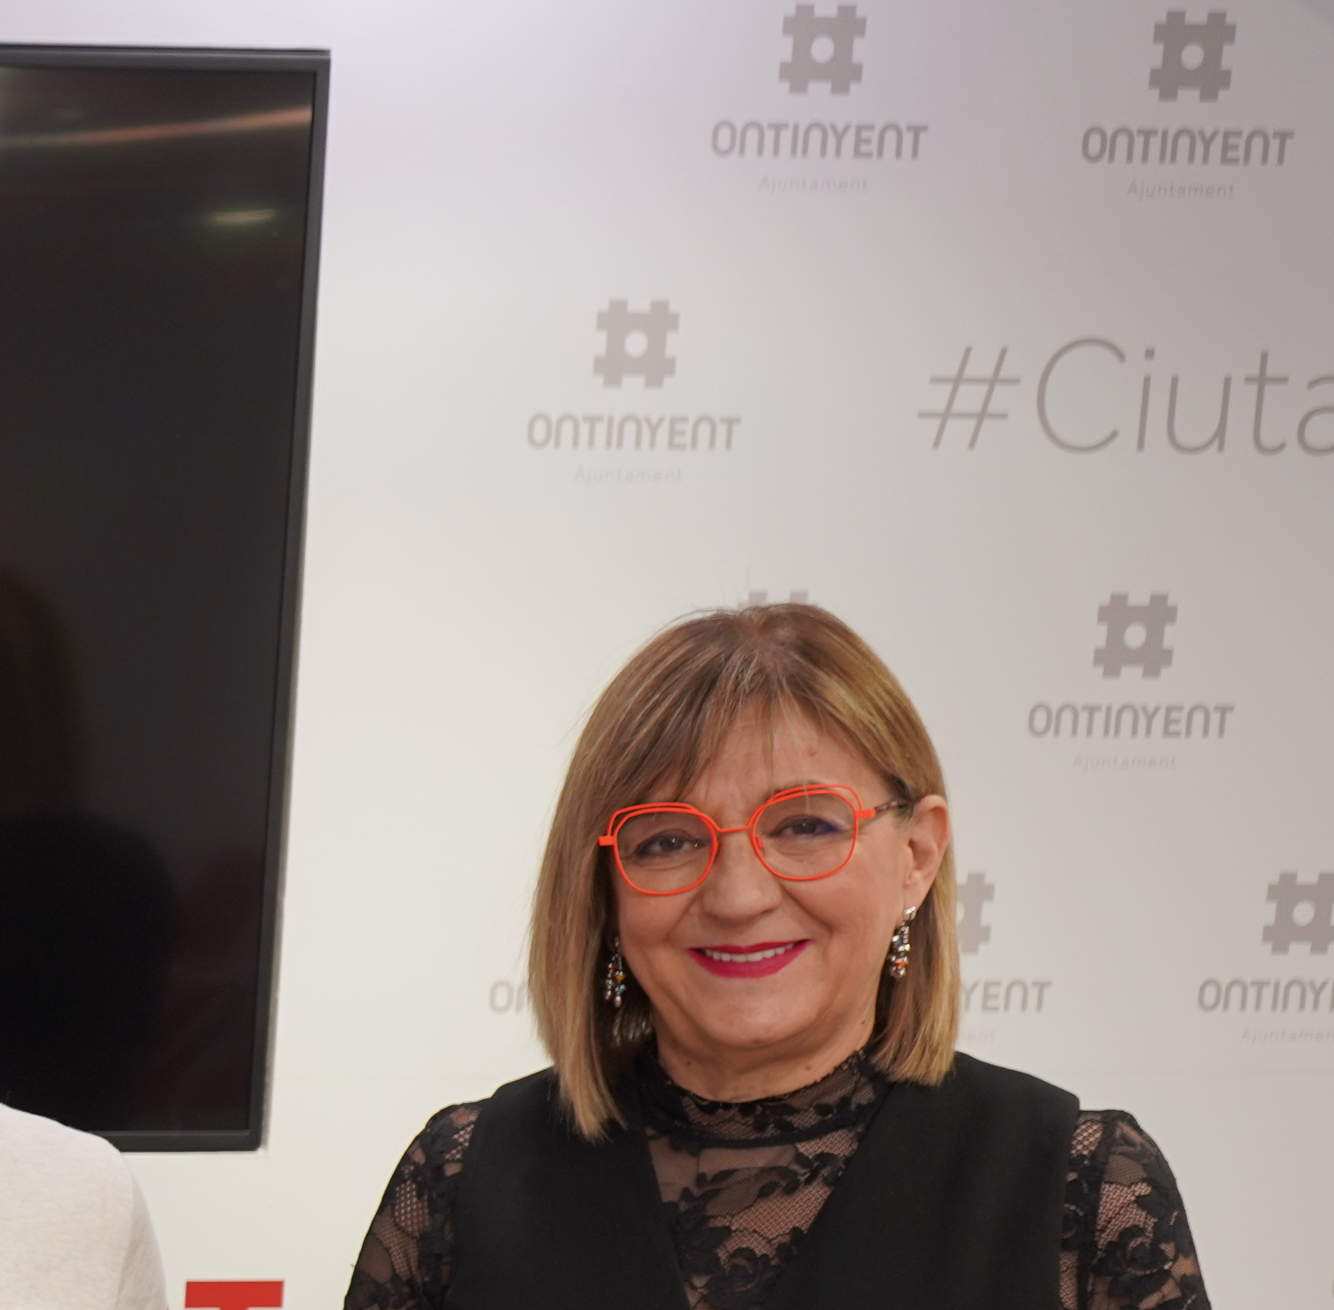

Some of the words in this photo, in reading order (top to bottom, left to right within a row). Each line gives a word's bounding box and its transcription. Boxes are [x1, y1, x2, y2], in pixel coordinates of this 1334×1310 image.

[712, 119, 928, 161] ONTINYENT
[1080, 125, 1295, 167] ONTINYENT
[527, 412, 741, 453] ONTINYENT
[1027, 701, 1234, 741] ONTINYENT
[1198, 977, 1334, 1016] ONTINY
